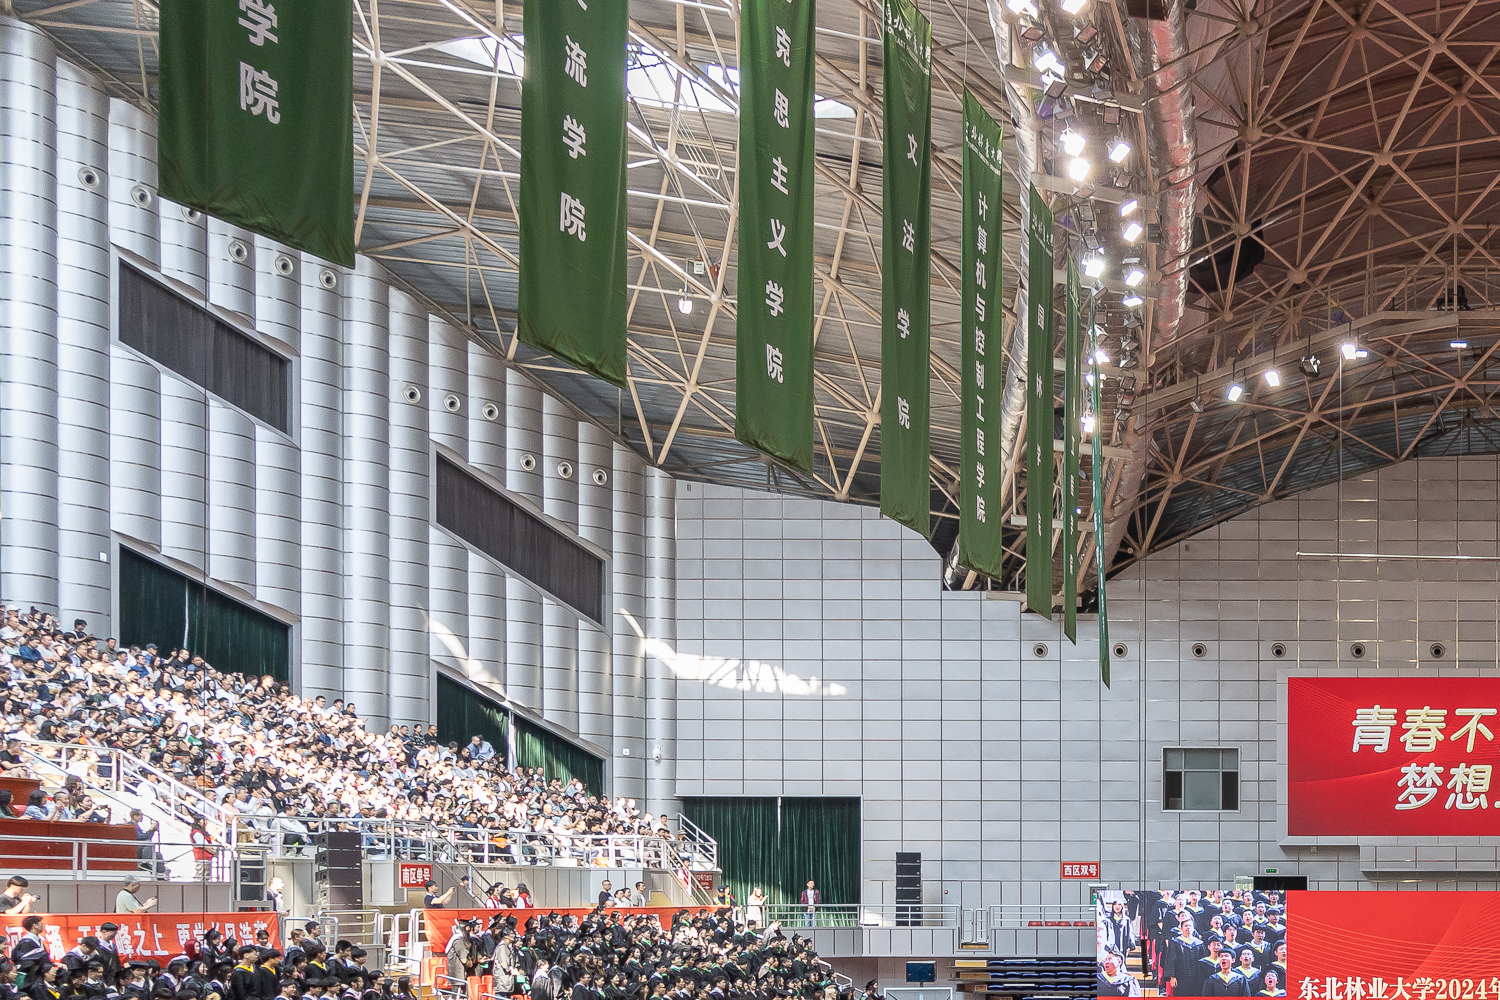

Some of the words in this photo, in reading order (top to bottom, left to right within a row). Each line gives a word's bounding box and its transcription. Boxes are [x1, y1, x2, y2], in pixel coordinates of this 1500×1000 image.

[238, 0, 281, 125] 学院
[559, 0, 588, 242] 流学院
[765, 0, 793, 384] 克思主义学院
[896, 133, 918, 430] 文法学院
[975, 191, 989, 524] 计算机与控制工程学院
[401, 866, 431, 885] 南区单号
[1063, 864, 1097, 877] 西区双号
